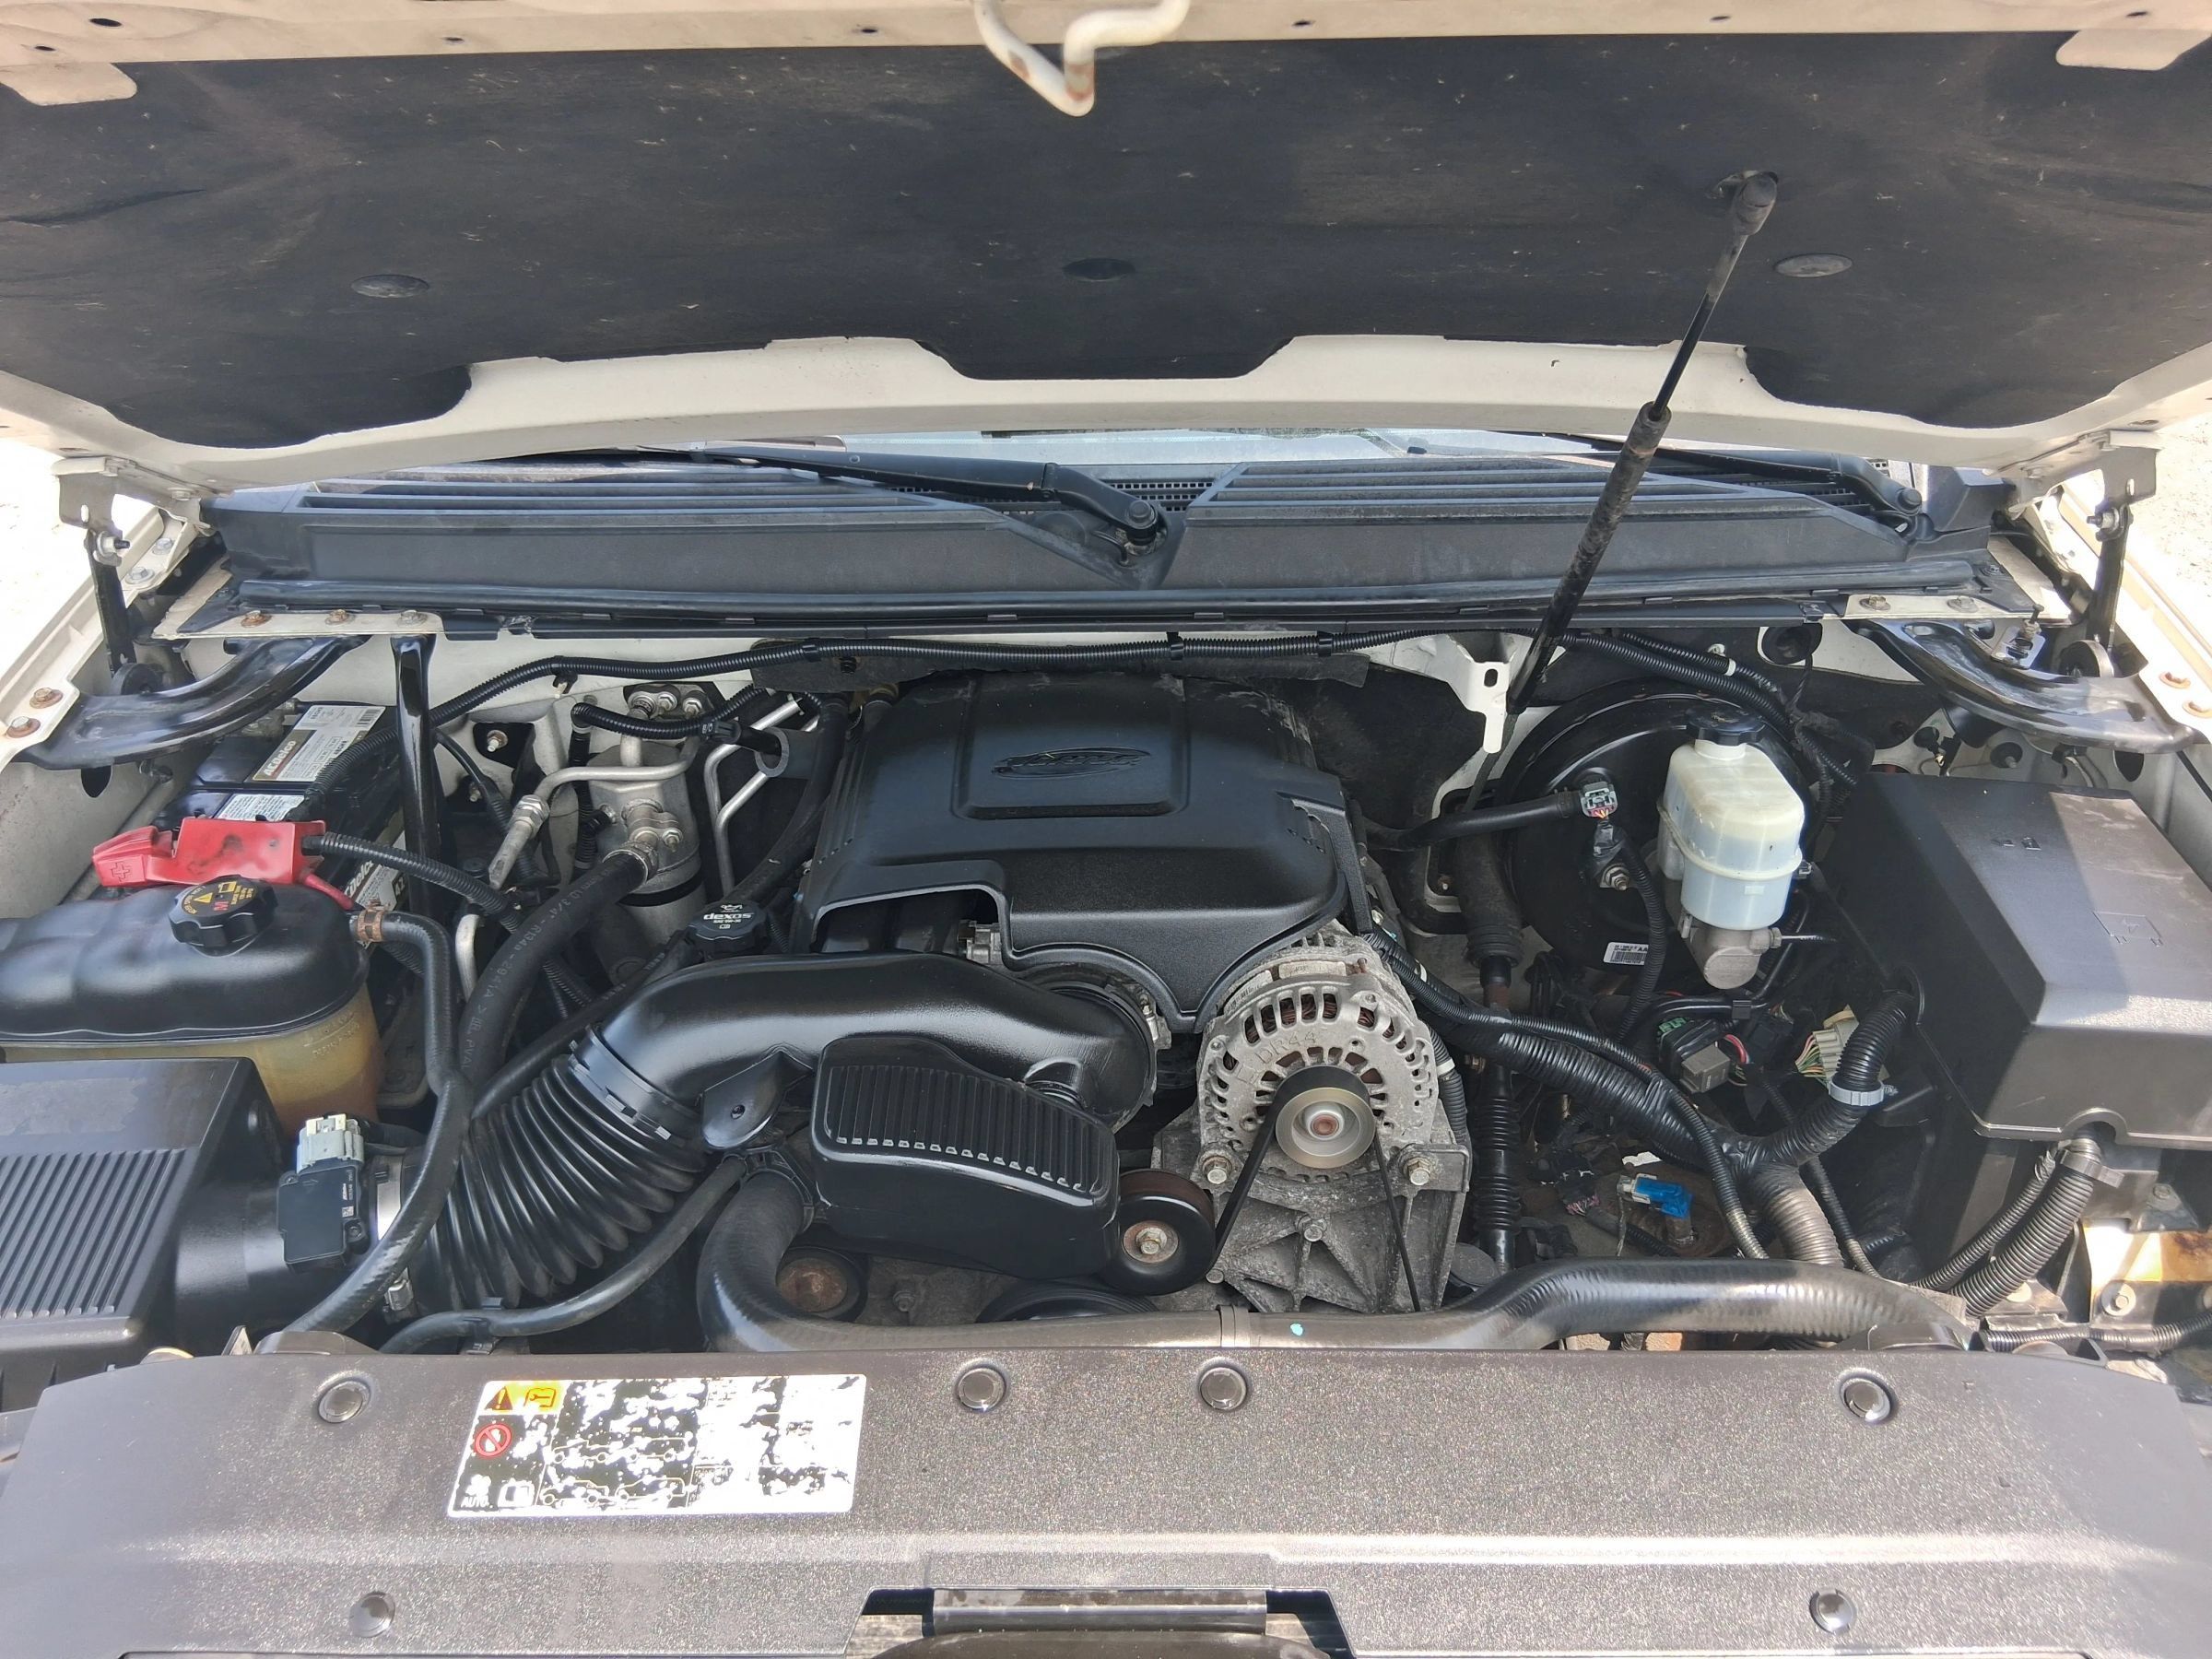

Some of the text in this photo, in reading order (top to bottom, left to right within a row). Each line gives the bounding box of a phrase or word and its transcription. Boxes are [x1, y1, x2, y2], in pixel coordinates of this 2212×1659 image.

[263, 740, 297, 776] ACDelco
[344, 860, 374, 898] CDelc
[702, 912, 754, 921] dexos
